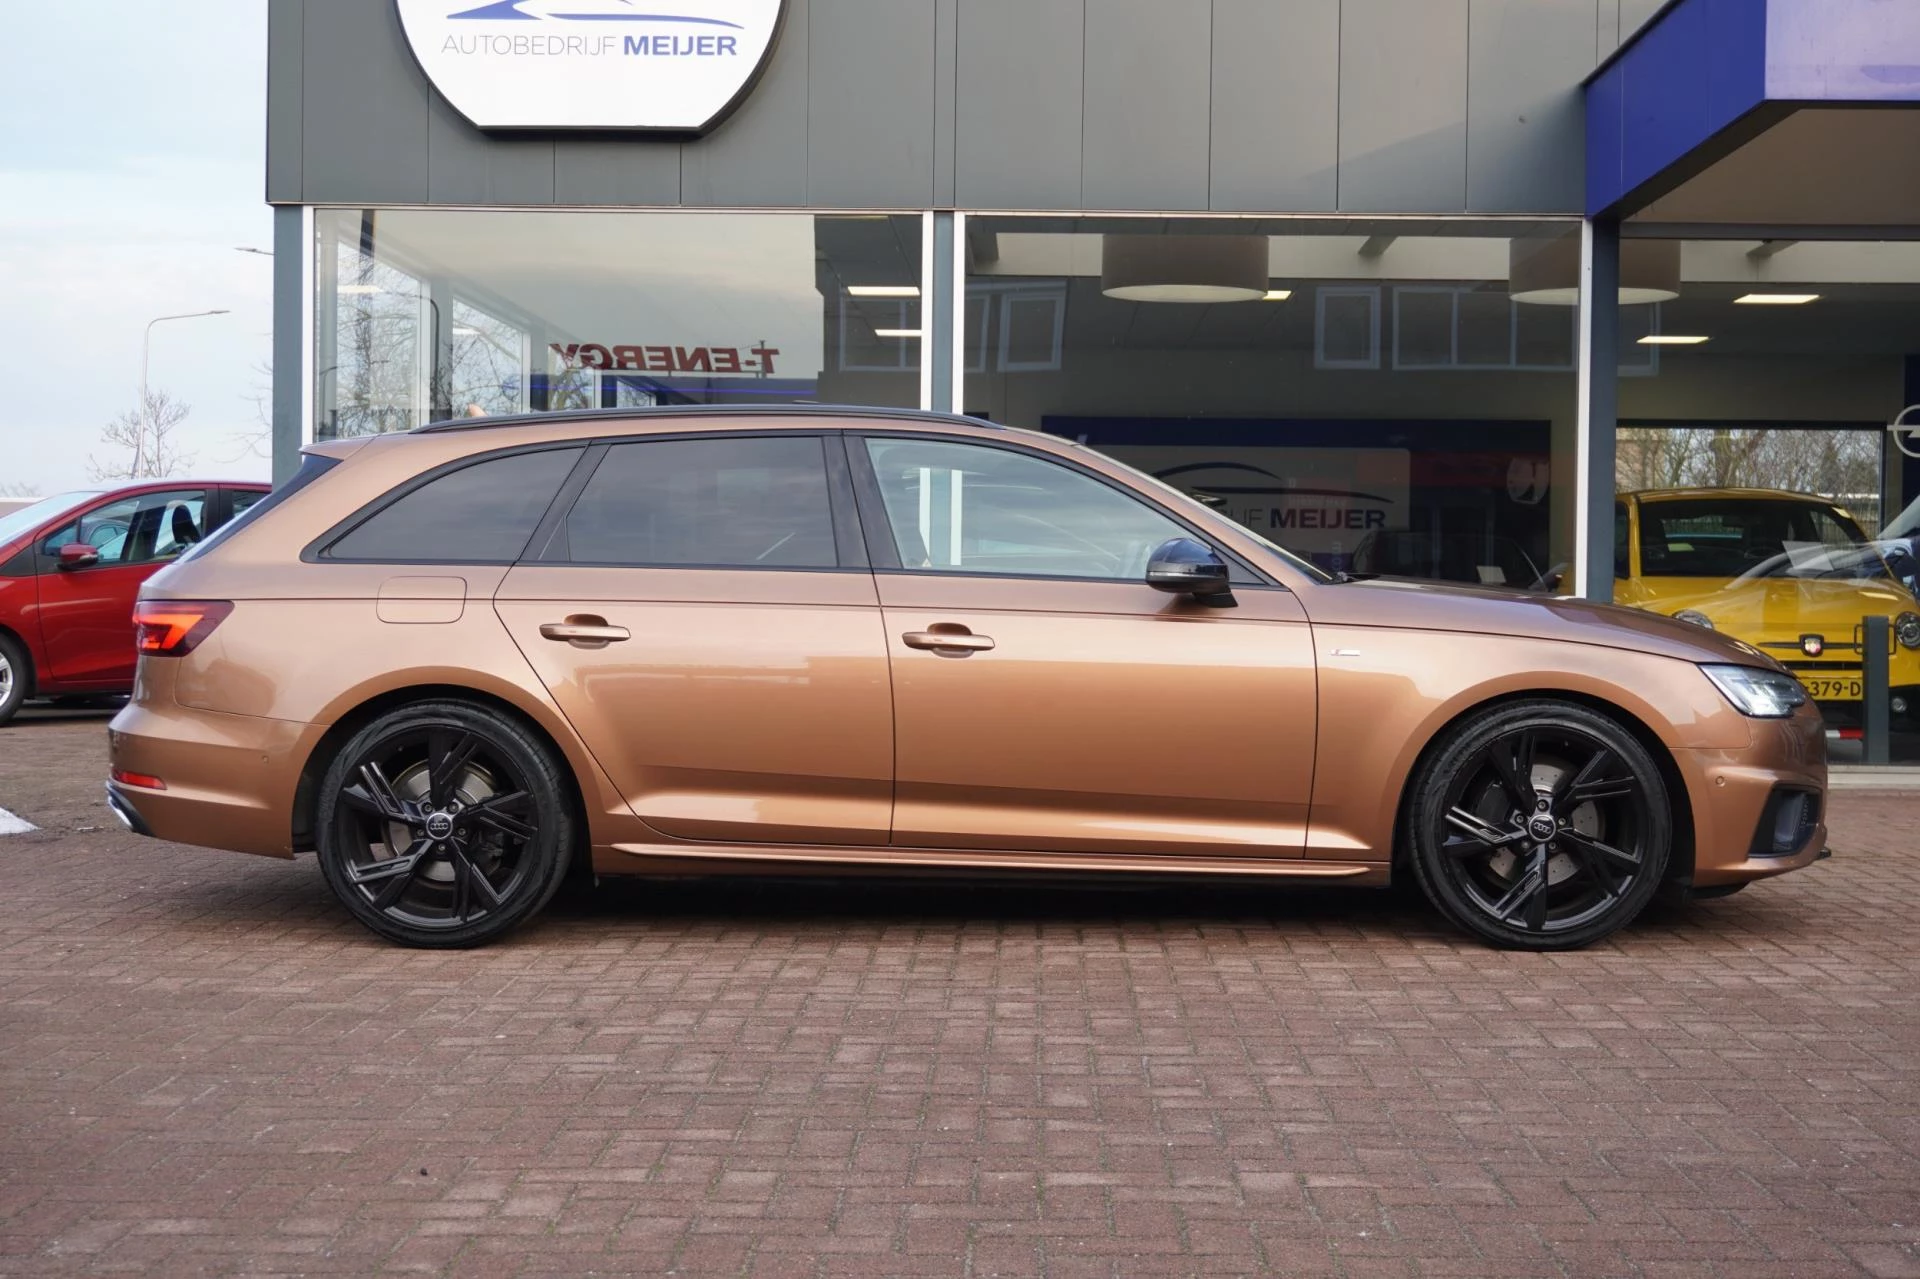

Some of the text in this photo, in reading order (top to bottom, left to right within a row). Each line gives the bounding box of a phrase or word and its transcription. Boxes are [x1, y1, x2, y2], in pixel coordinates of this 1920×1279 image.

[441, 35, 737, 56] AUTOBEDRIJF MEIJER
[1270, 508, 1386, 529] MEIJER
